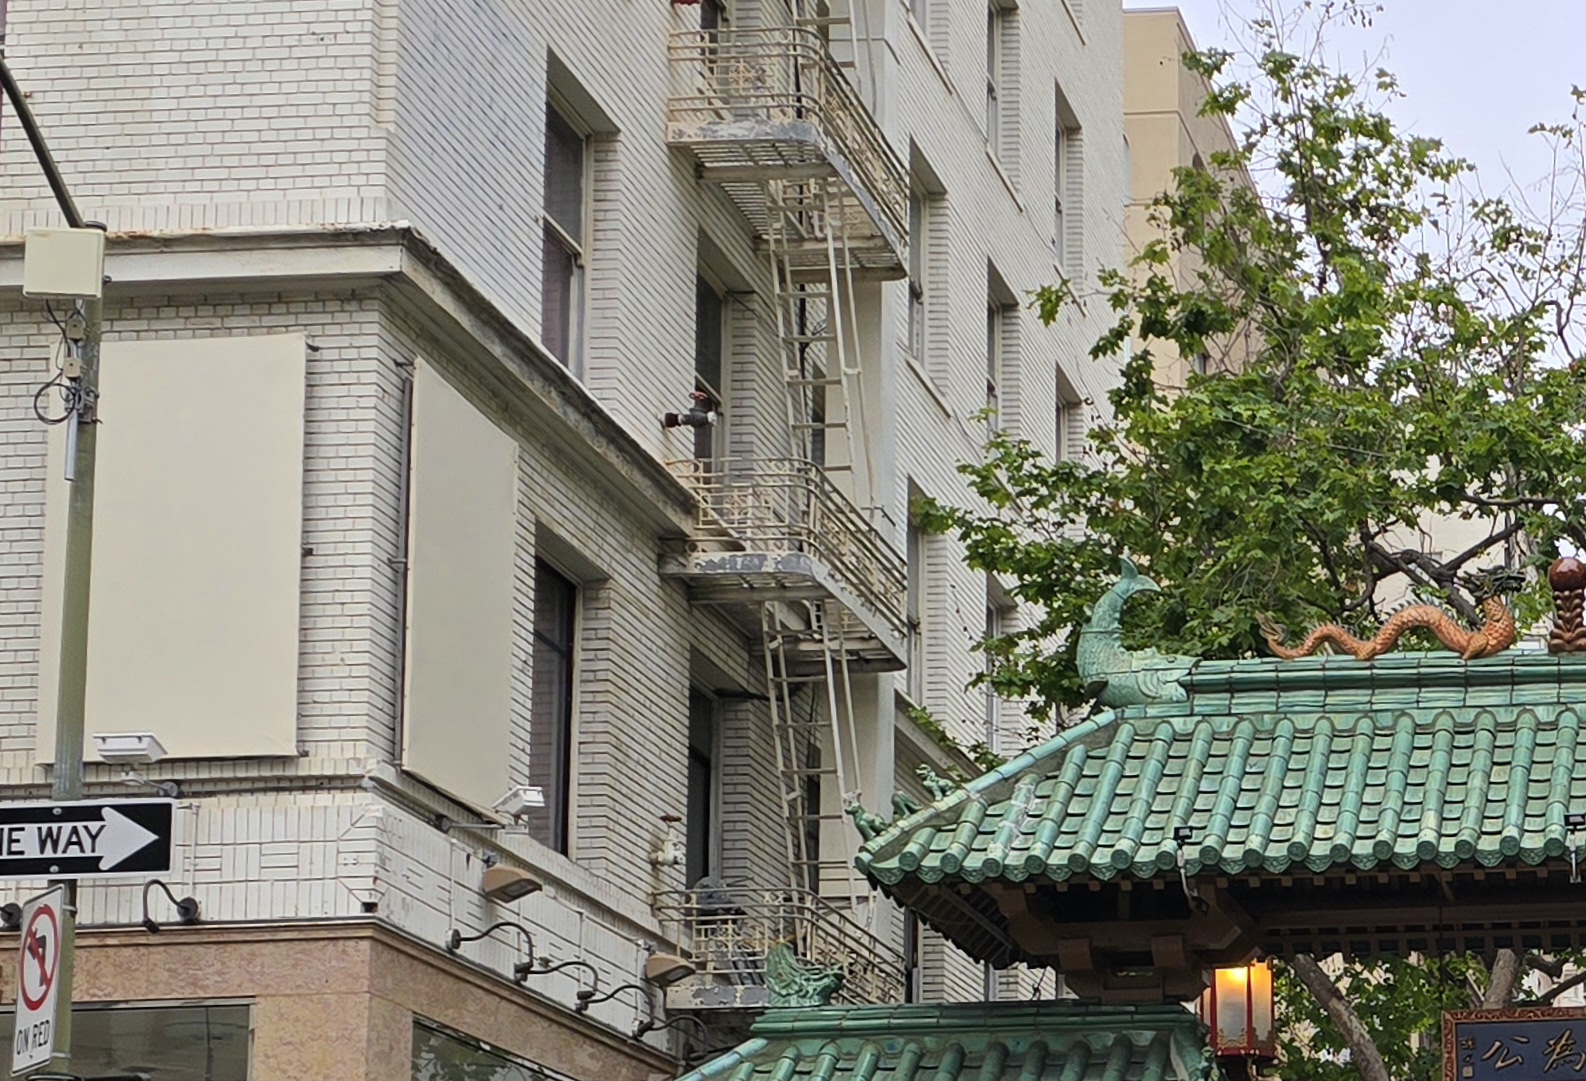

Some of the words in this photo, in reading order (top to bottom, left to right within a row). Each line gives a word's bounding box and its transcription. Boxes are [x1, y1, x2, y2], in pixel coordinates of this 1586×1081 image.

[37, 824, 106, 856] WAY
[16, 1029, 30, 1055] ON
[31, 1019, 50, 1051] RED
